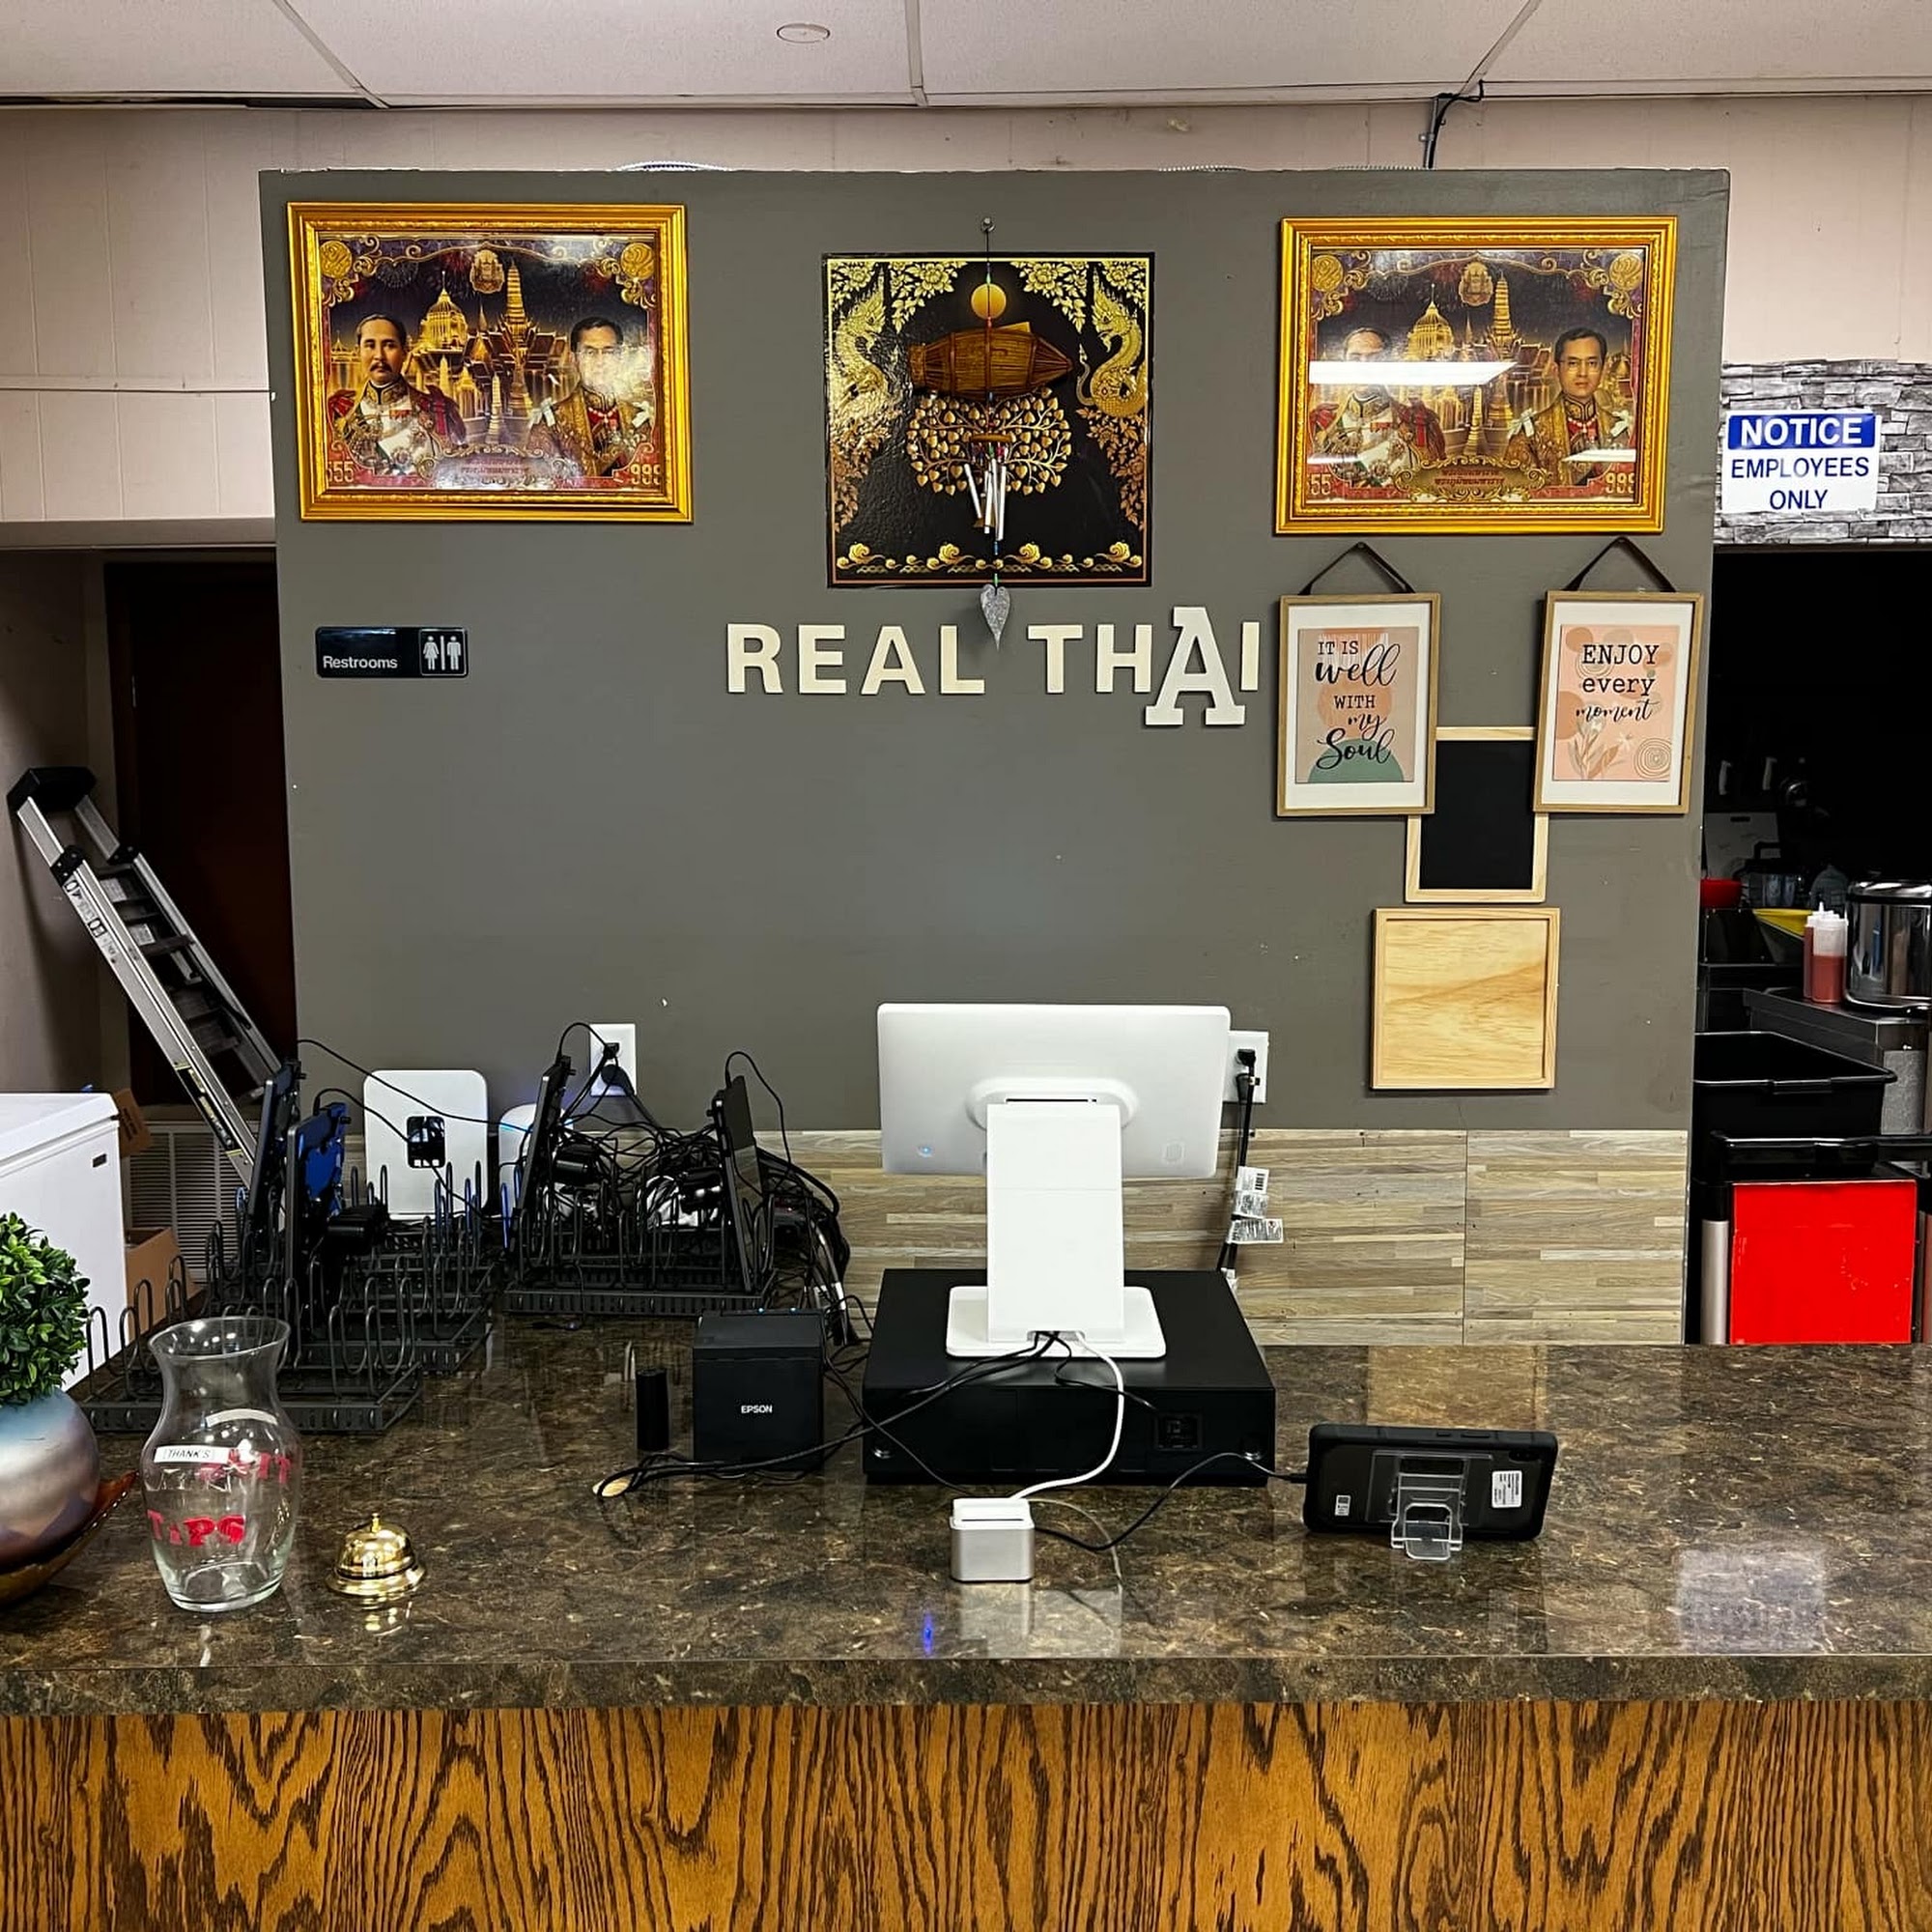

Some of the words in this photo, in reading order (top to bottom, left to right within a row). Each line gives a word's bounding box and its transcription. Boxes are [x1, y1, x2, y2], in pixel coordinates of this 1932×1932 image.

[1741, 417, 1862, 445] NOTICE
[1731, 457, 1869, 478] EMPLOYEES
[1770, 490, 1828, 509] ONLY
[1318, 641, 1335, 655] IT
[1341, 640, 1359, 655] IS
[1582, 644, 1660, 665] ENJOY
[323, 656, 398, 668] Restrooms
[726, 623, 985, 695] REAL
[1027, 606, 1261, 726] THAI
[1315, 643, 1401, 687] well
[1582, 677, 1656, 696] every
[1334, 695, 1375, 709] WITH
[1576, 698, 1661, 723] moment
[1348, 713, 1387, 742] my
[1316, 727, 1395, 769] Soul
[741, 1405, 773, 1413] EPSON
